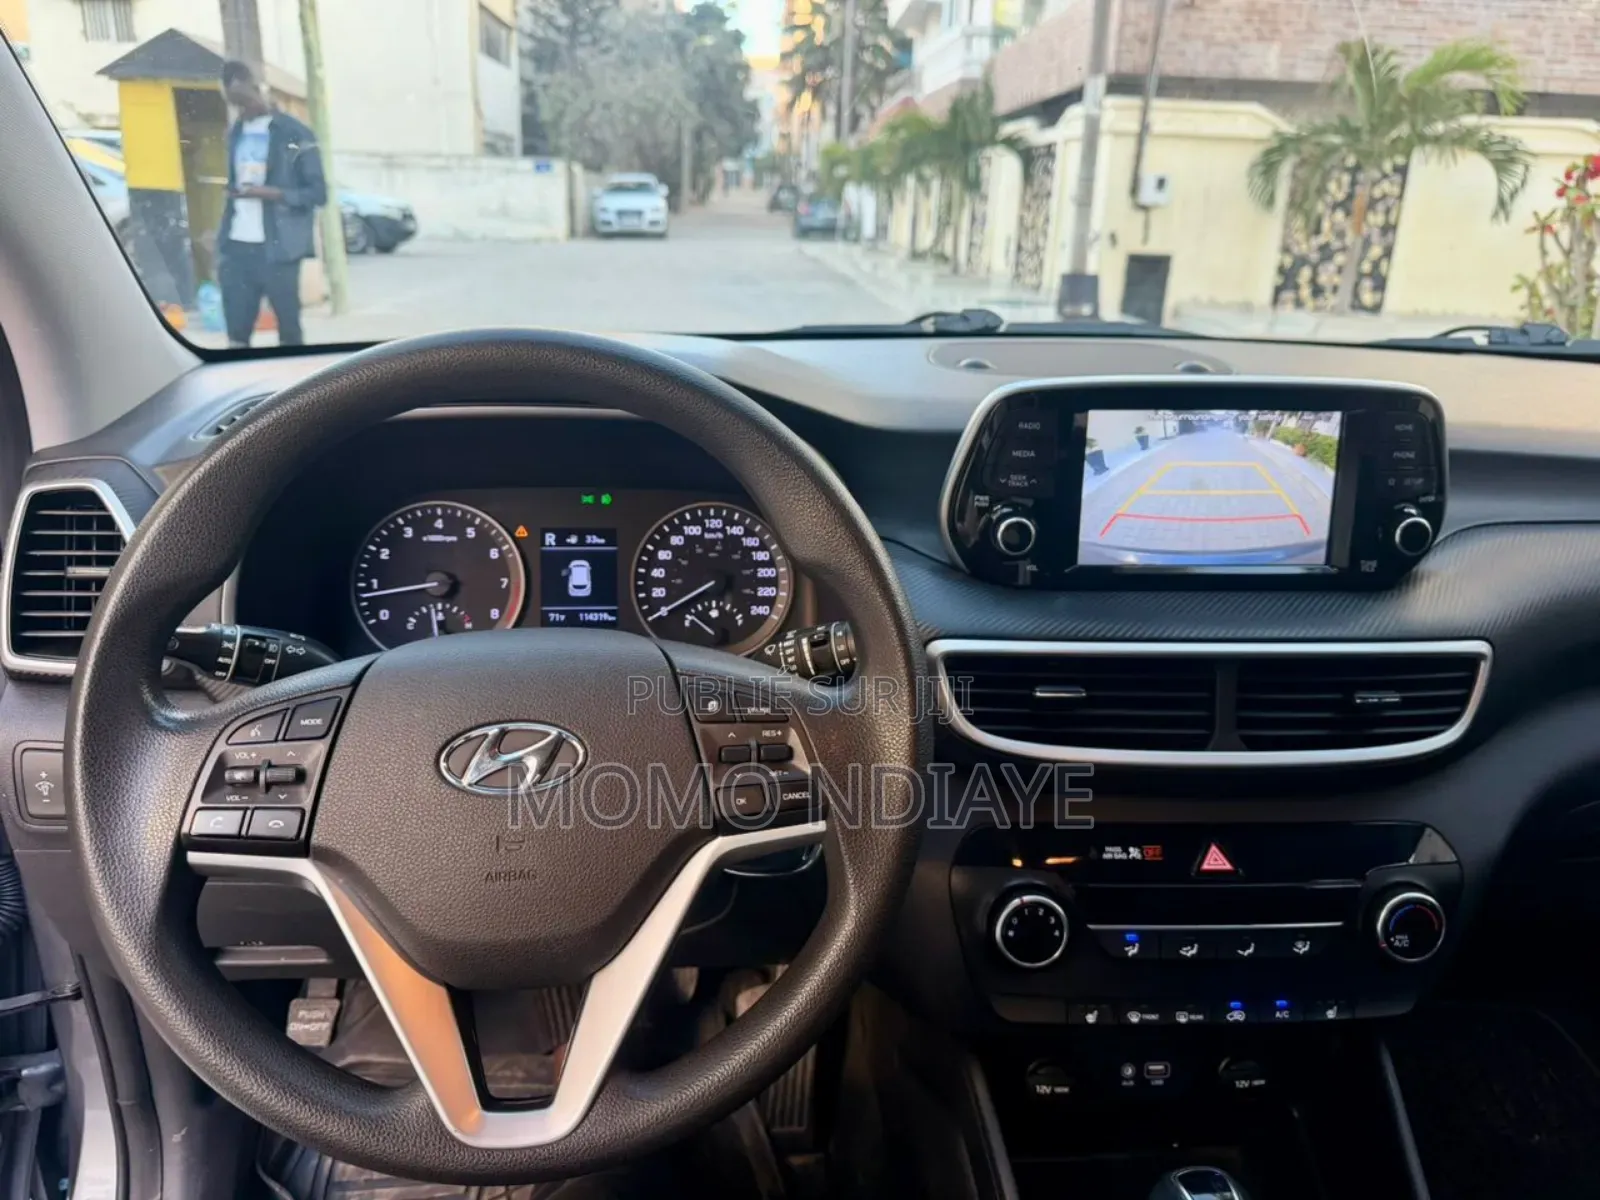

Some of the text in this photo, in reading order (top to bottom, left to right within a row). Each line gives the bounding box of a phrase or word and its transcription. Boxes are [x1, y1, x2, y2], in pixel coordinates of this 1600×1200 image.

[1018, 421, 1041, 430] RADIO
[1012, 450, 1036, 458] MEDIA
[434, 518, 444, 529] 4
[704, 519, 723, 528] 120
[403, 527, 413, 538] 3
[466, 527, 476, 538] 5
[683, 525, 702, 535] 100
[725, 526, 744, 536] 140
[544, 532, 556, 546] R
[670, 535, 684, 545] 80
[704, 532, 724, 540] km/h
[741, 537, 760, 547] 160
[379, 548, 390, 560] 2
[489, 548, 499, 559] 6
[657, 550, 672, 560] 60
[751, 550, 770, 560] 180
[651, 568, 665, 578] 40
[757, 568, 777, 577] 200
[371, 579, 378, 589] 1
[500, 578, 508, 589] 7
[651, 587, 666, 597] 20
[757, 586, 777, 597] 220
[379, 609, 390, 620] 0
[490, 609, 499, 620] 8
[750, 605, 770, 615] 240
[300, 718, 324, 726] MODE
[782, 791, 811, 800] CANCEL
[735, 797, 747, 806] OK
[485, 870, 538, 884] AIRBAG
[1275, 1010, 1289, 1019] A/C
[1235, 1080, 1250, 1088] 12V
[1036, 1085, 1051, 1094] 12V
